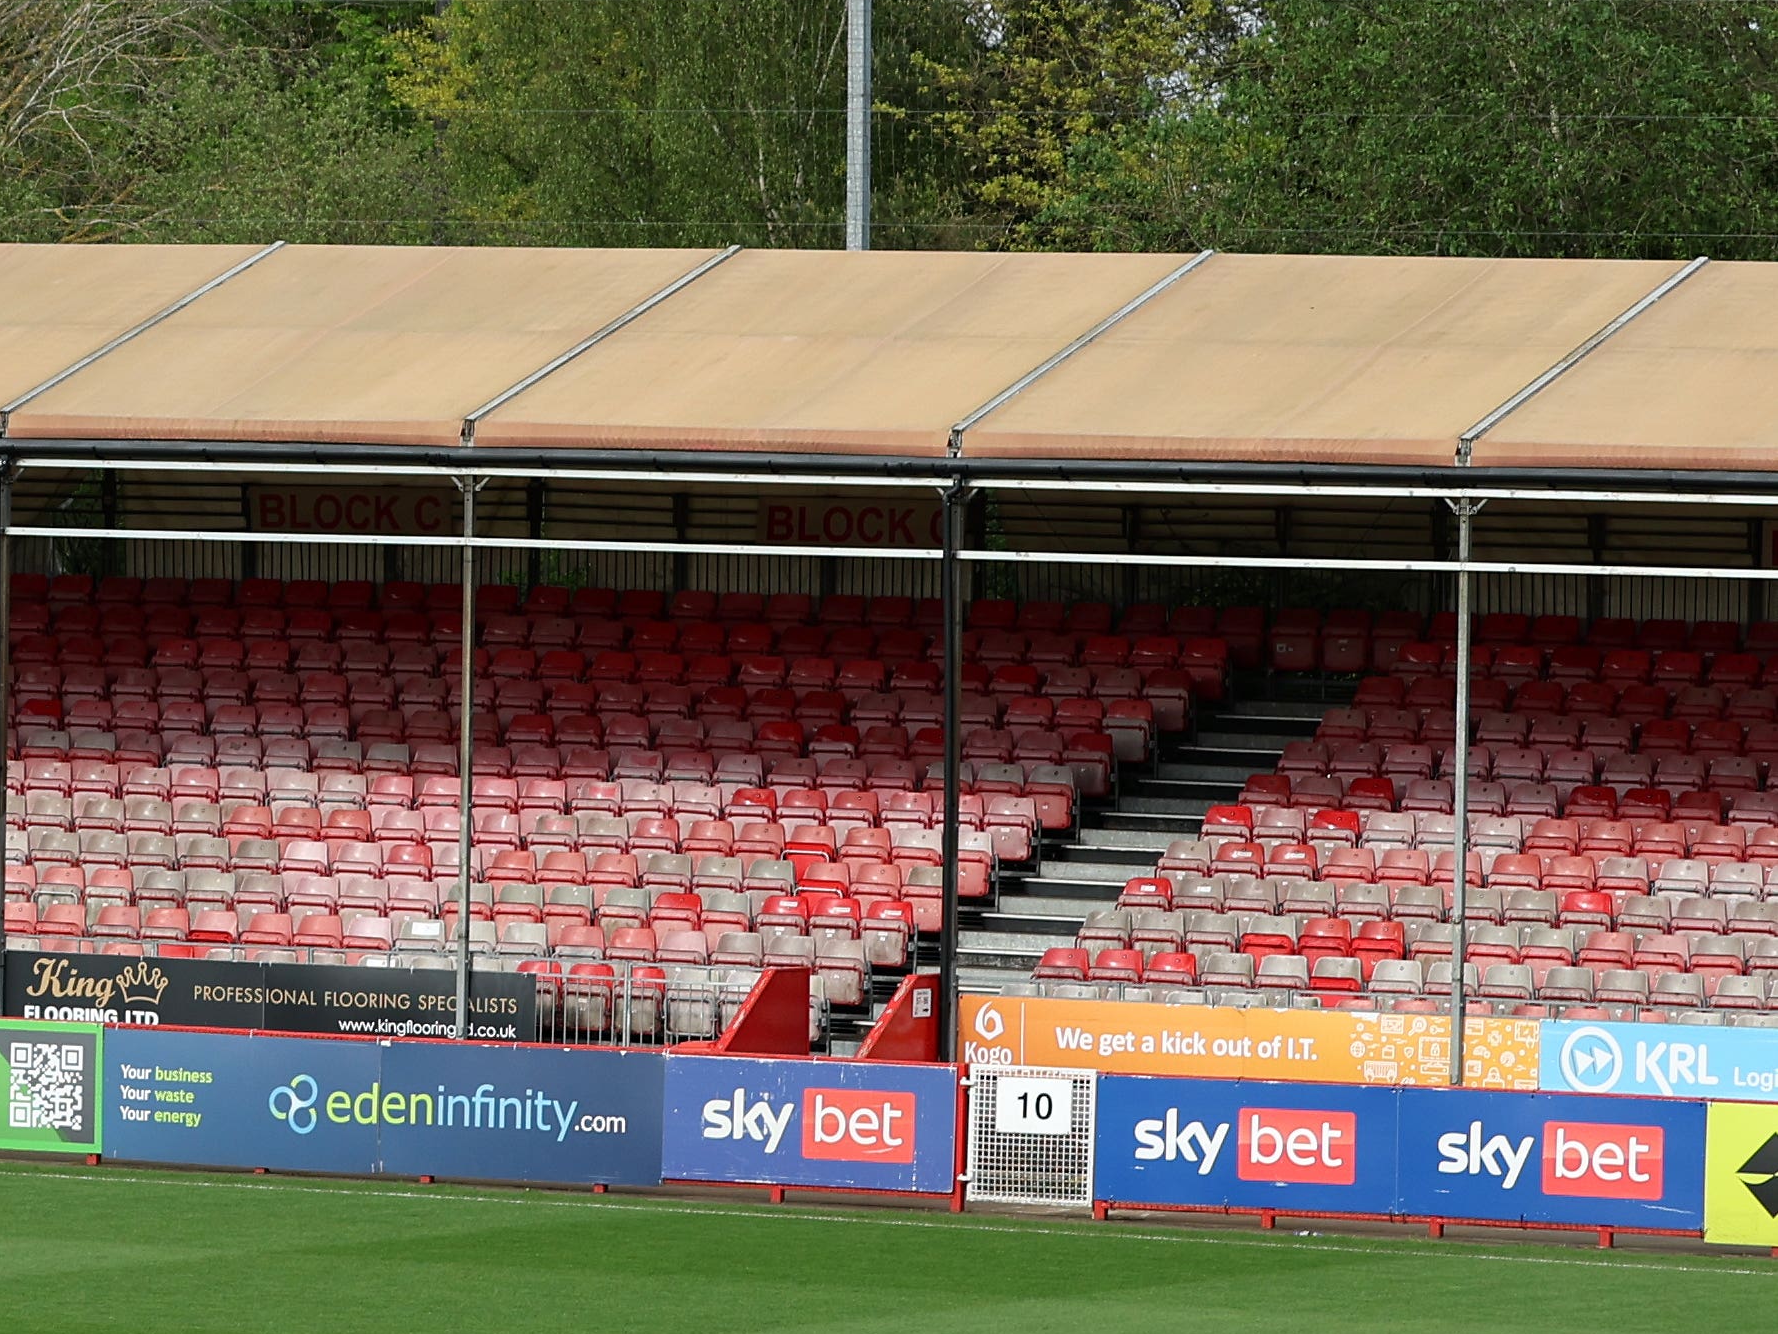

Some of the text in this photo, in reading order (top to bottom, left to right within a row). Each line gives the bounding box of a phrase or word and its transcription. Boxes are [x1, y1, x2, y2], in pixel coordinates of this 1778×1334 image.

[259, 494, 441, 531] BLOCK C
[766, 505, 916, 545] BLOCK
[26, 957, 116, 1008] King
[193, 984, 518, 1015] PROFESSIONAL FLOORING SPECLISTS
[23, 1004, 160, 1026] FLOORING LTD
[338, 1018, 517, 1040] www.kingflooringd.co.uk
[964, 1040, 1013, 1066] Kogo
[1054, 1026, 1318, 1061] We get a kick out of I.T.
[120, 1063, 214, 1084] Your business
[1635, 1040, 1719, 1096] KRL
[120, 1084, 195, 1104] Your waste
[1017, 1091, 1053, 1120] 10
[120, 1105, 202, 1128] Your energy
[326, 1082, 627, 1142] edeninfinity.com
[702, 1087, 903, 1154] sky bet
[1134, 1107, 1343, 1176] sky bet
[1437, 1120, 1650, 1190] sky bet
